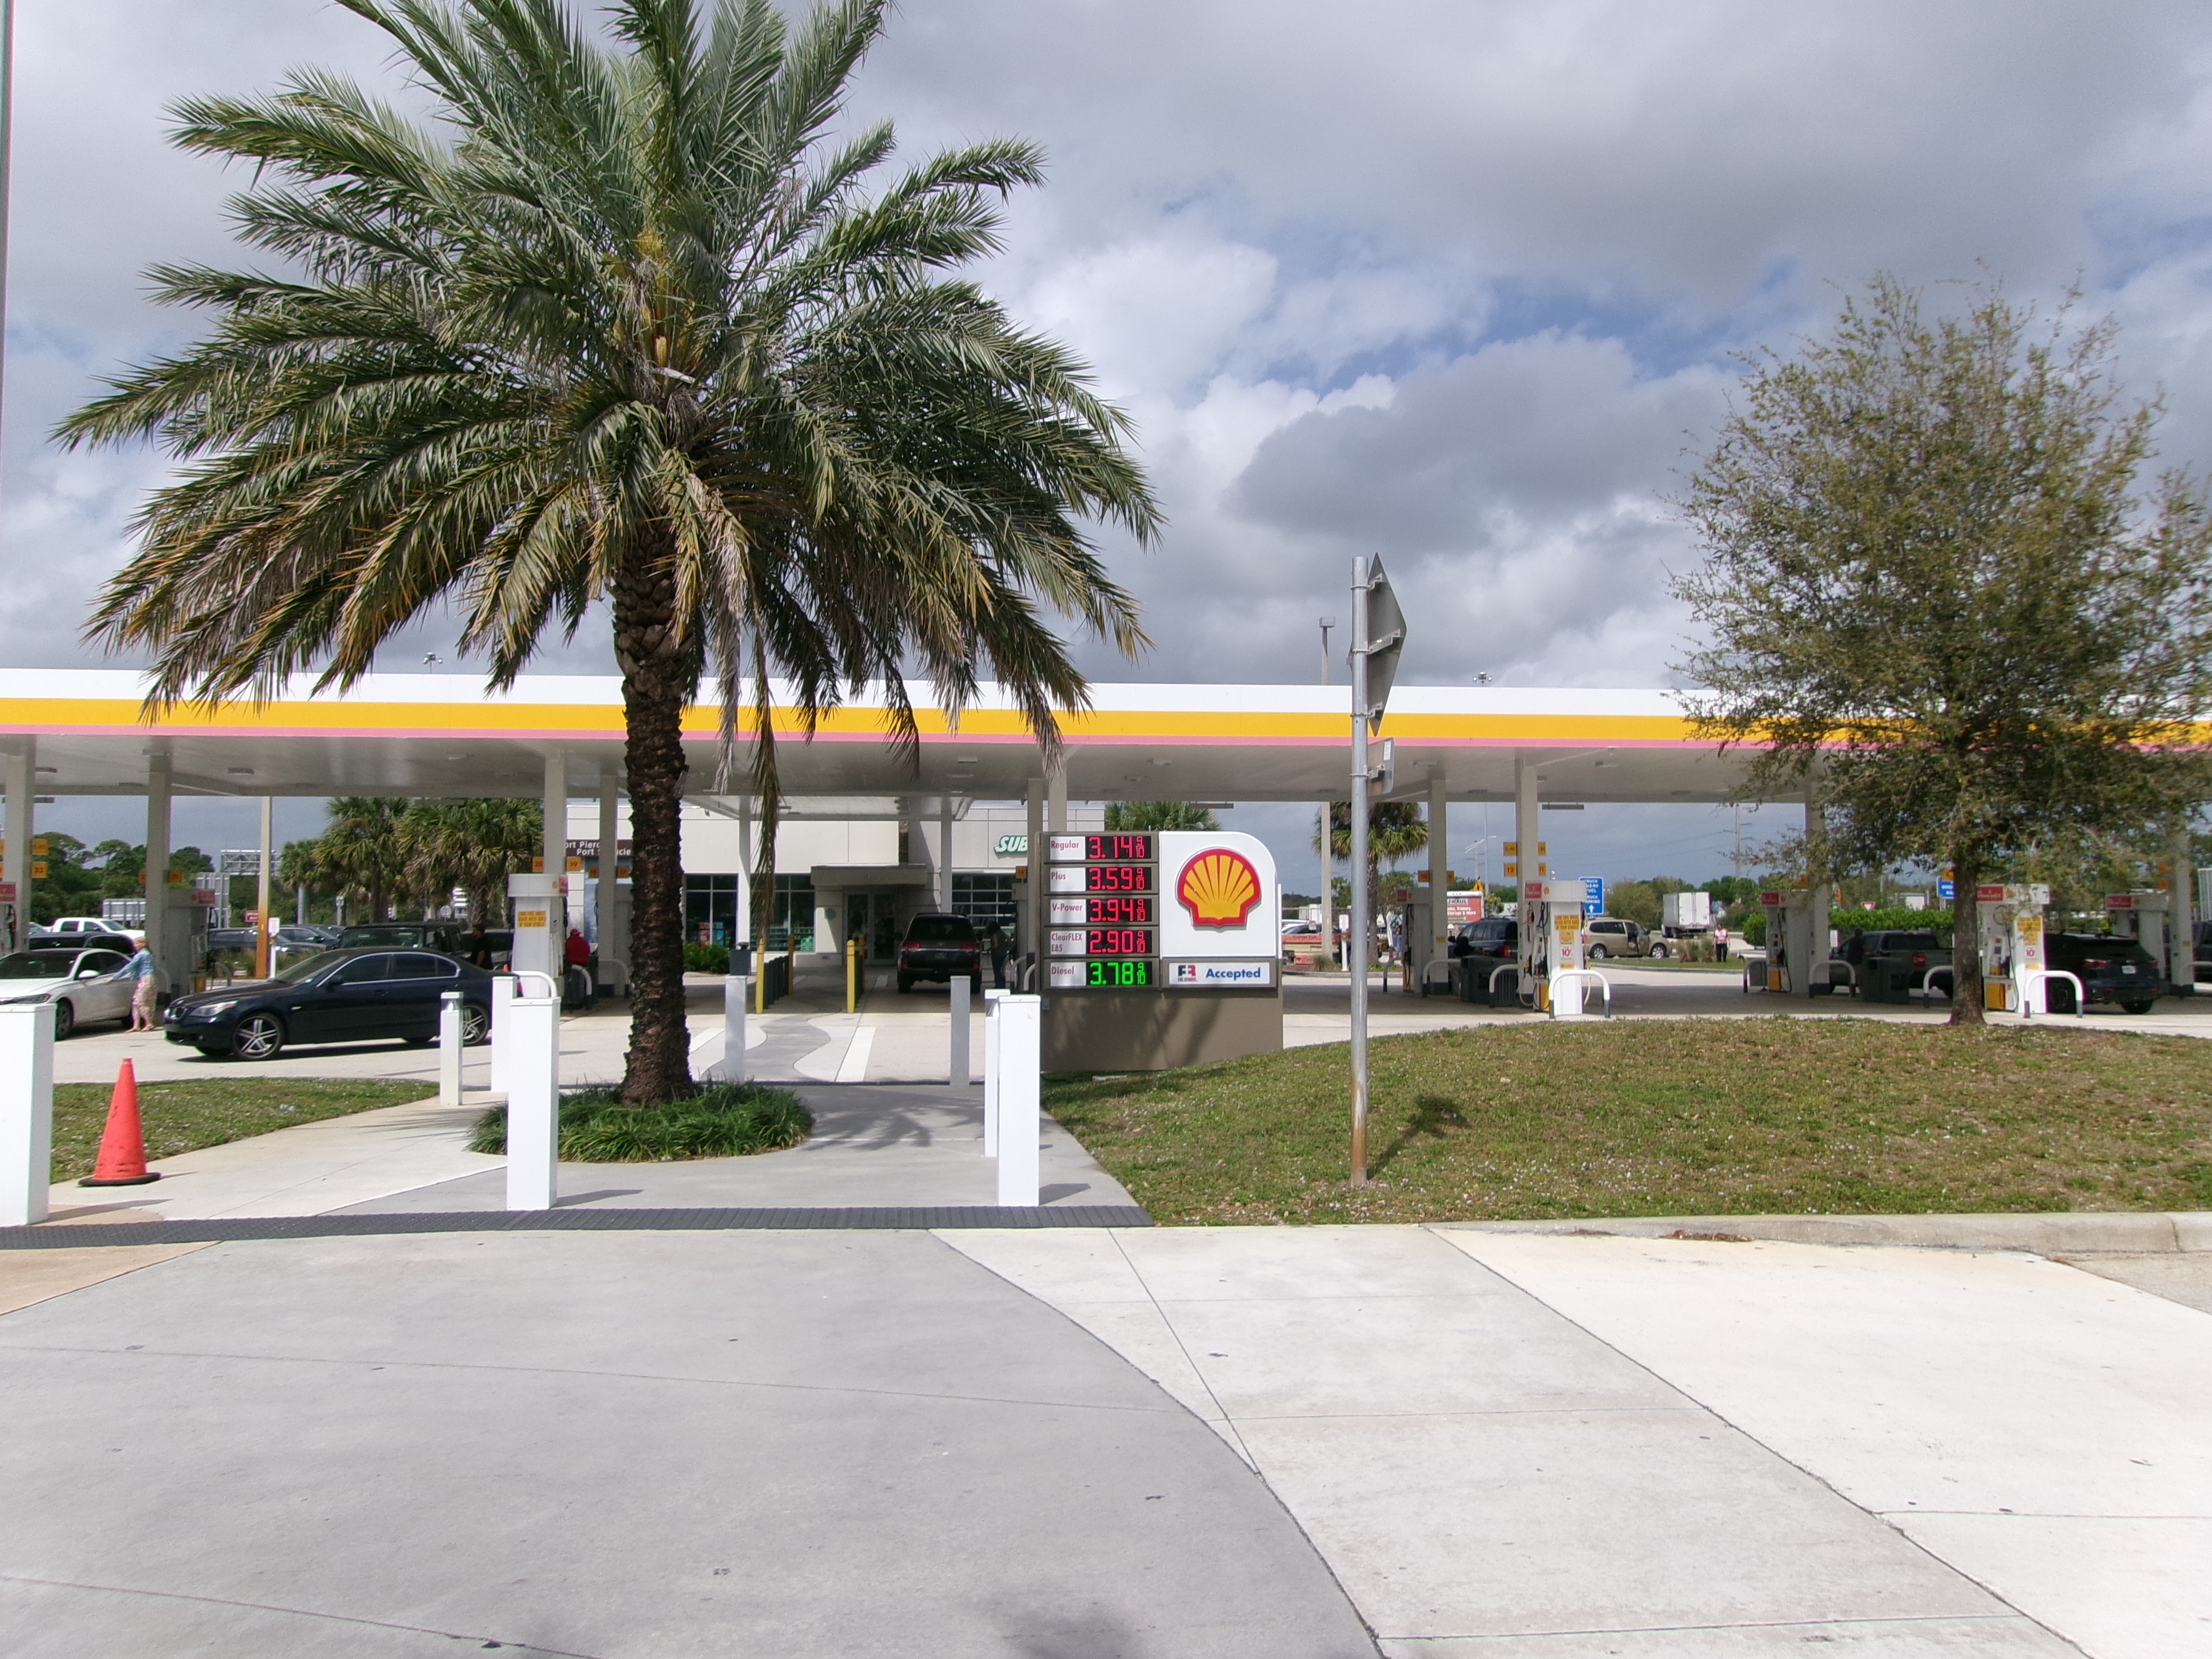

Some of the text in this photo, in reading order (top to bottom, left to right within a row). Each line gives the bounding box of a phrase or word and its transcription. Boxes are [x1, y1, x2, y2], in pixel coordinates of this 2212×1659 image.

[994, 836, 1027, 853] SUB
[1051, 840, 1079, 850] Regular
[1089, 836, 1132, 858] 3.14
[1051, 872, 1066, 880] Plus
[1089, 867, 1132, 890] 3.59
[1052, 903, 1082, 911] V-Power
[1090, 899, 1133, 921] 3.94
[1051, 944, 1062, 952] E85
[1090, 930, 1133, 953] 2.90
[1051, 966, 1074, 974] Diesel
[1090, 962, 1133, 985] 3.78
[1205, 967, 1261, 981] Accepted
